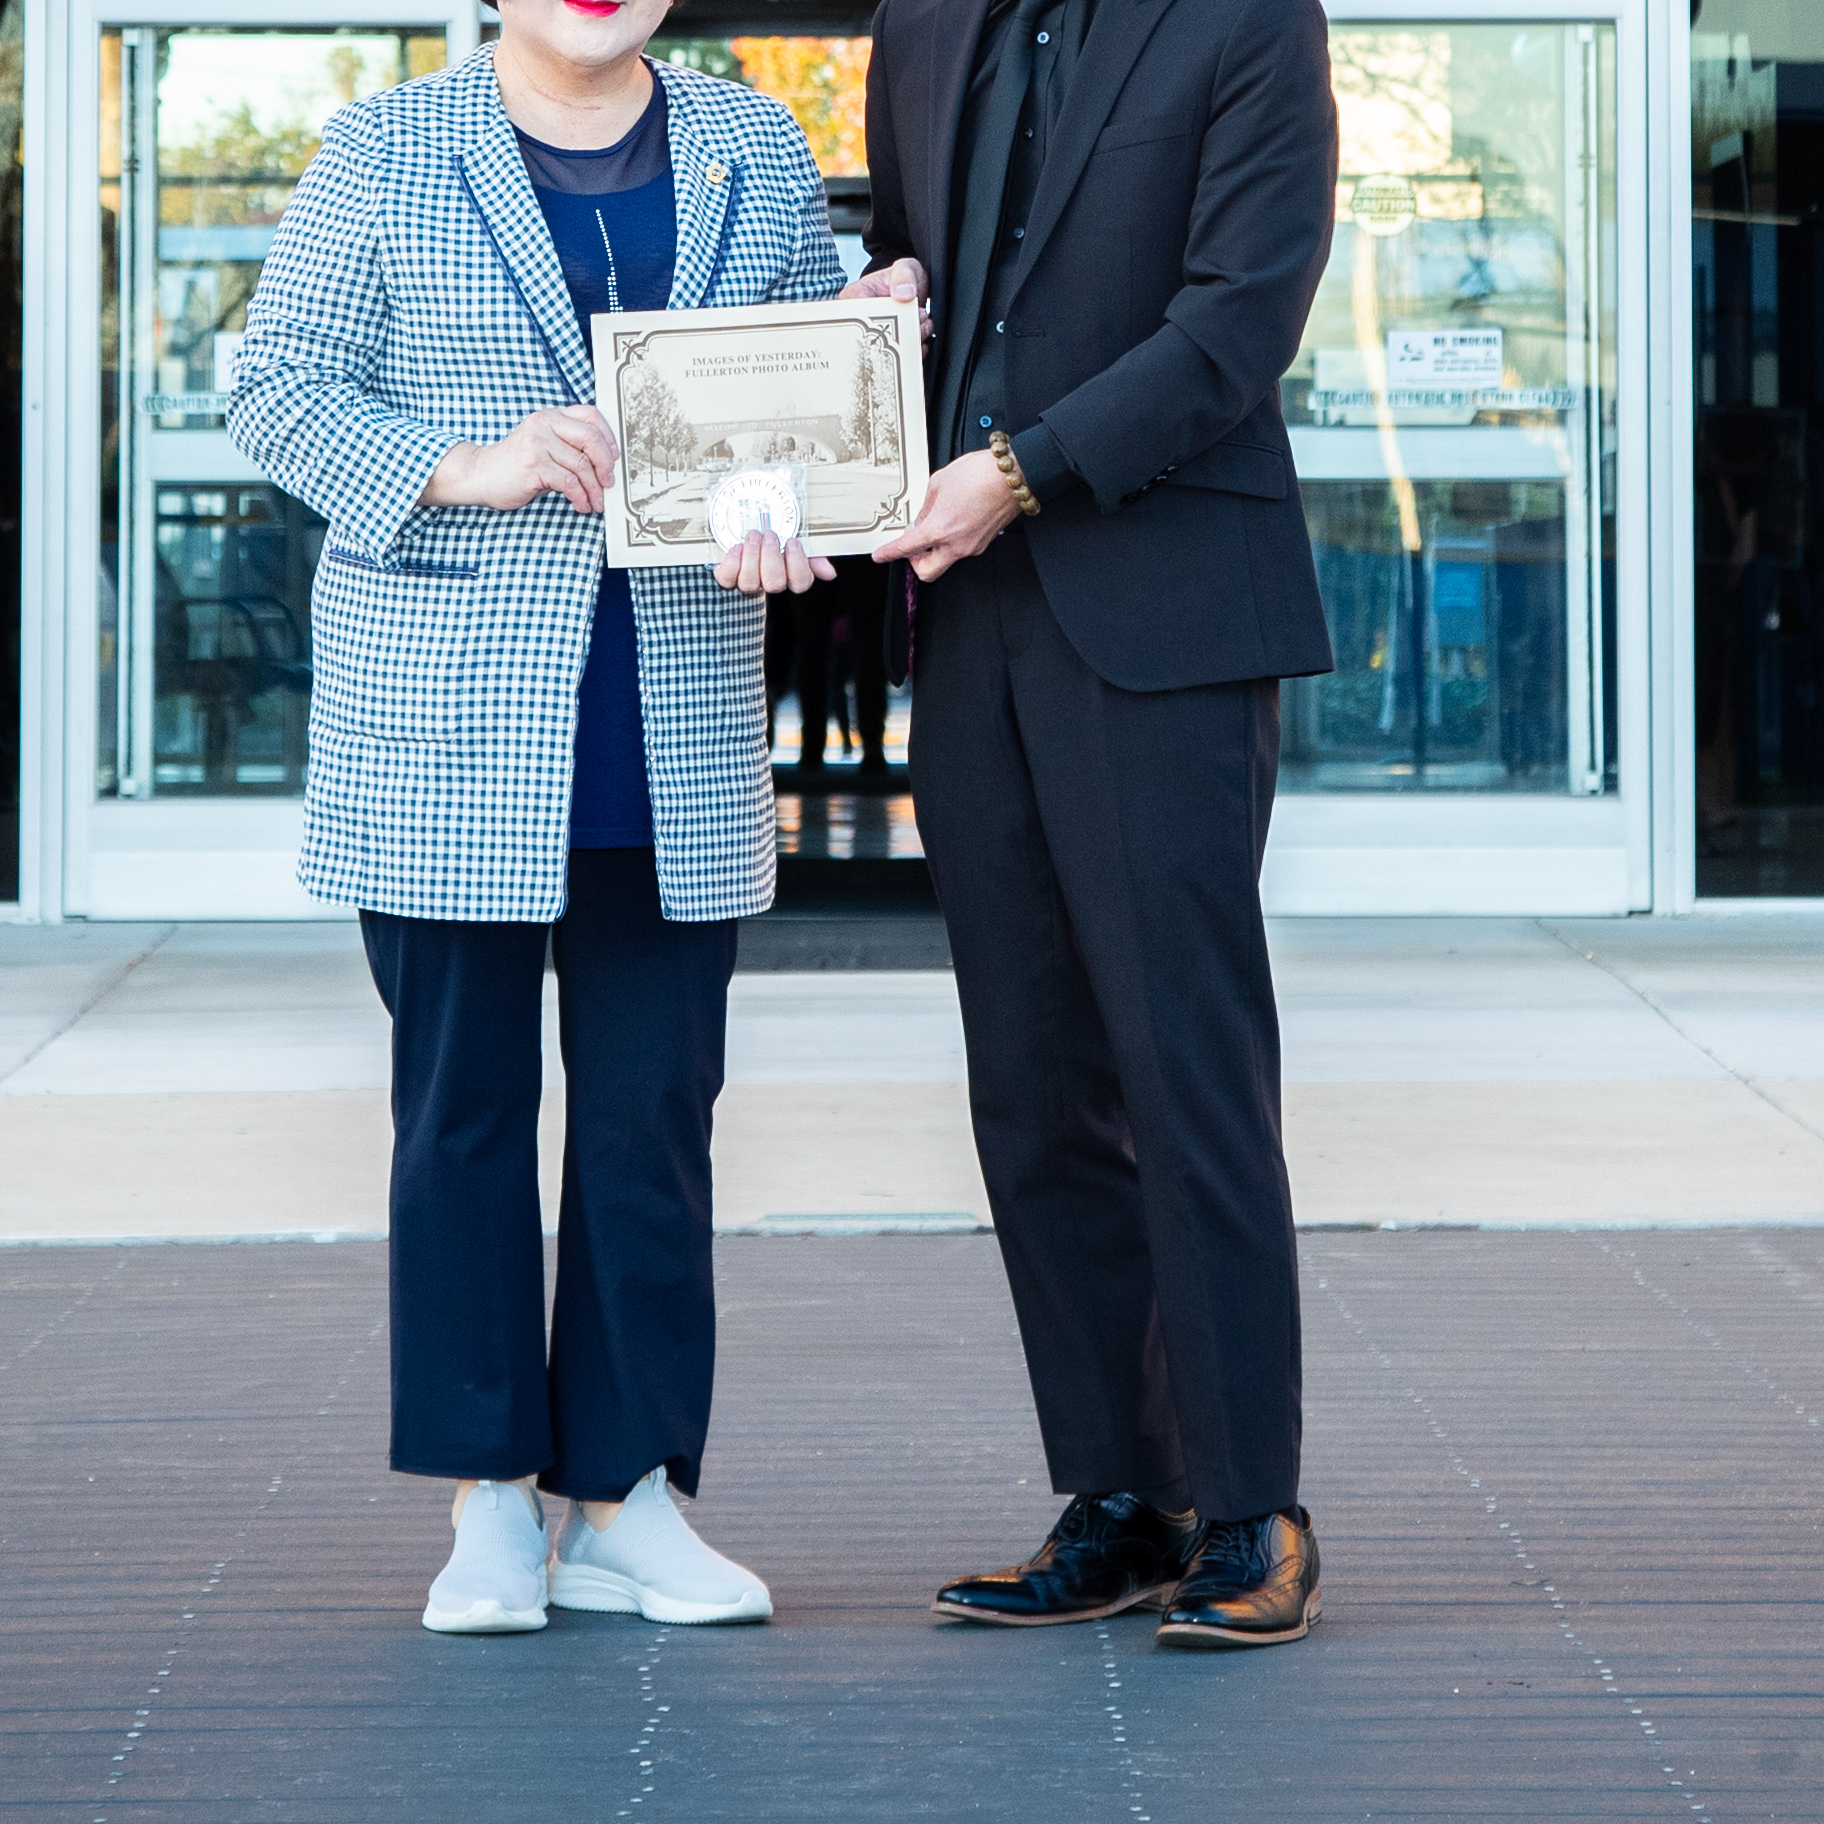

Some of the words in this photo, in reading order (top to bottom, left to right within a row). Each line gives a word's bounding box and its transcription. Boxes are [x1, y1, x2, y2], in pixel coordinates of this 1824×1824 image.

[1353, 198, 1415, 212] CAUTION
[692, 355, 735, 367] IMAGES
[737, 354, 752, 364] OF
[754, 350, 822, 363] YESTERDAY:
[685, 366, 749, 378] FULLERTON
[752, 364, 789, 375] PHOTO
[791, 361, 830, 372] ALBUM
